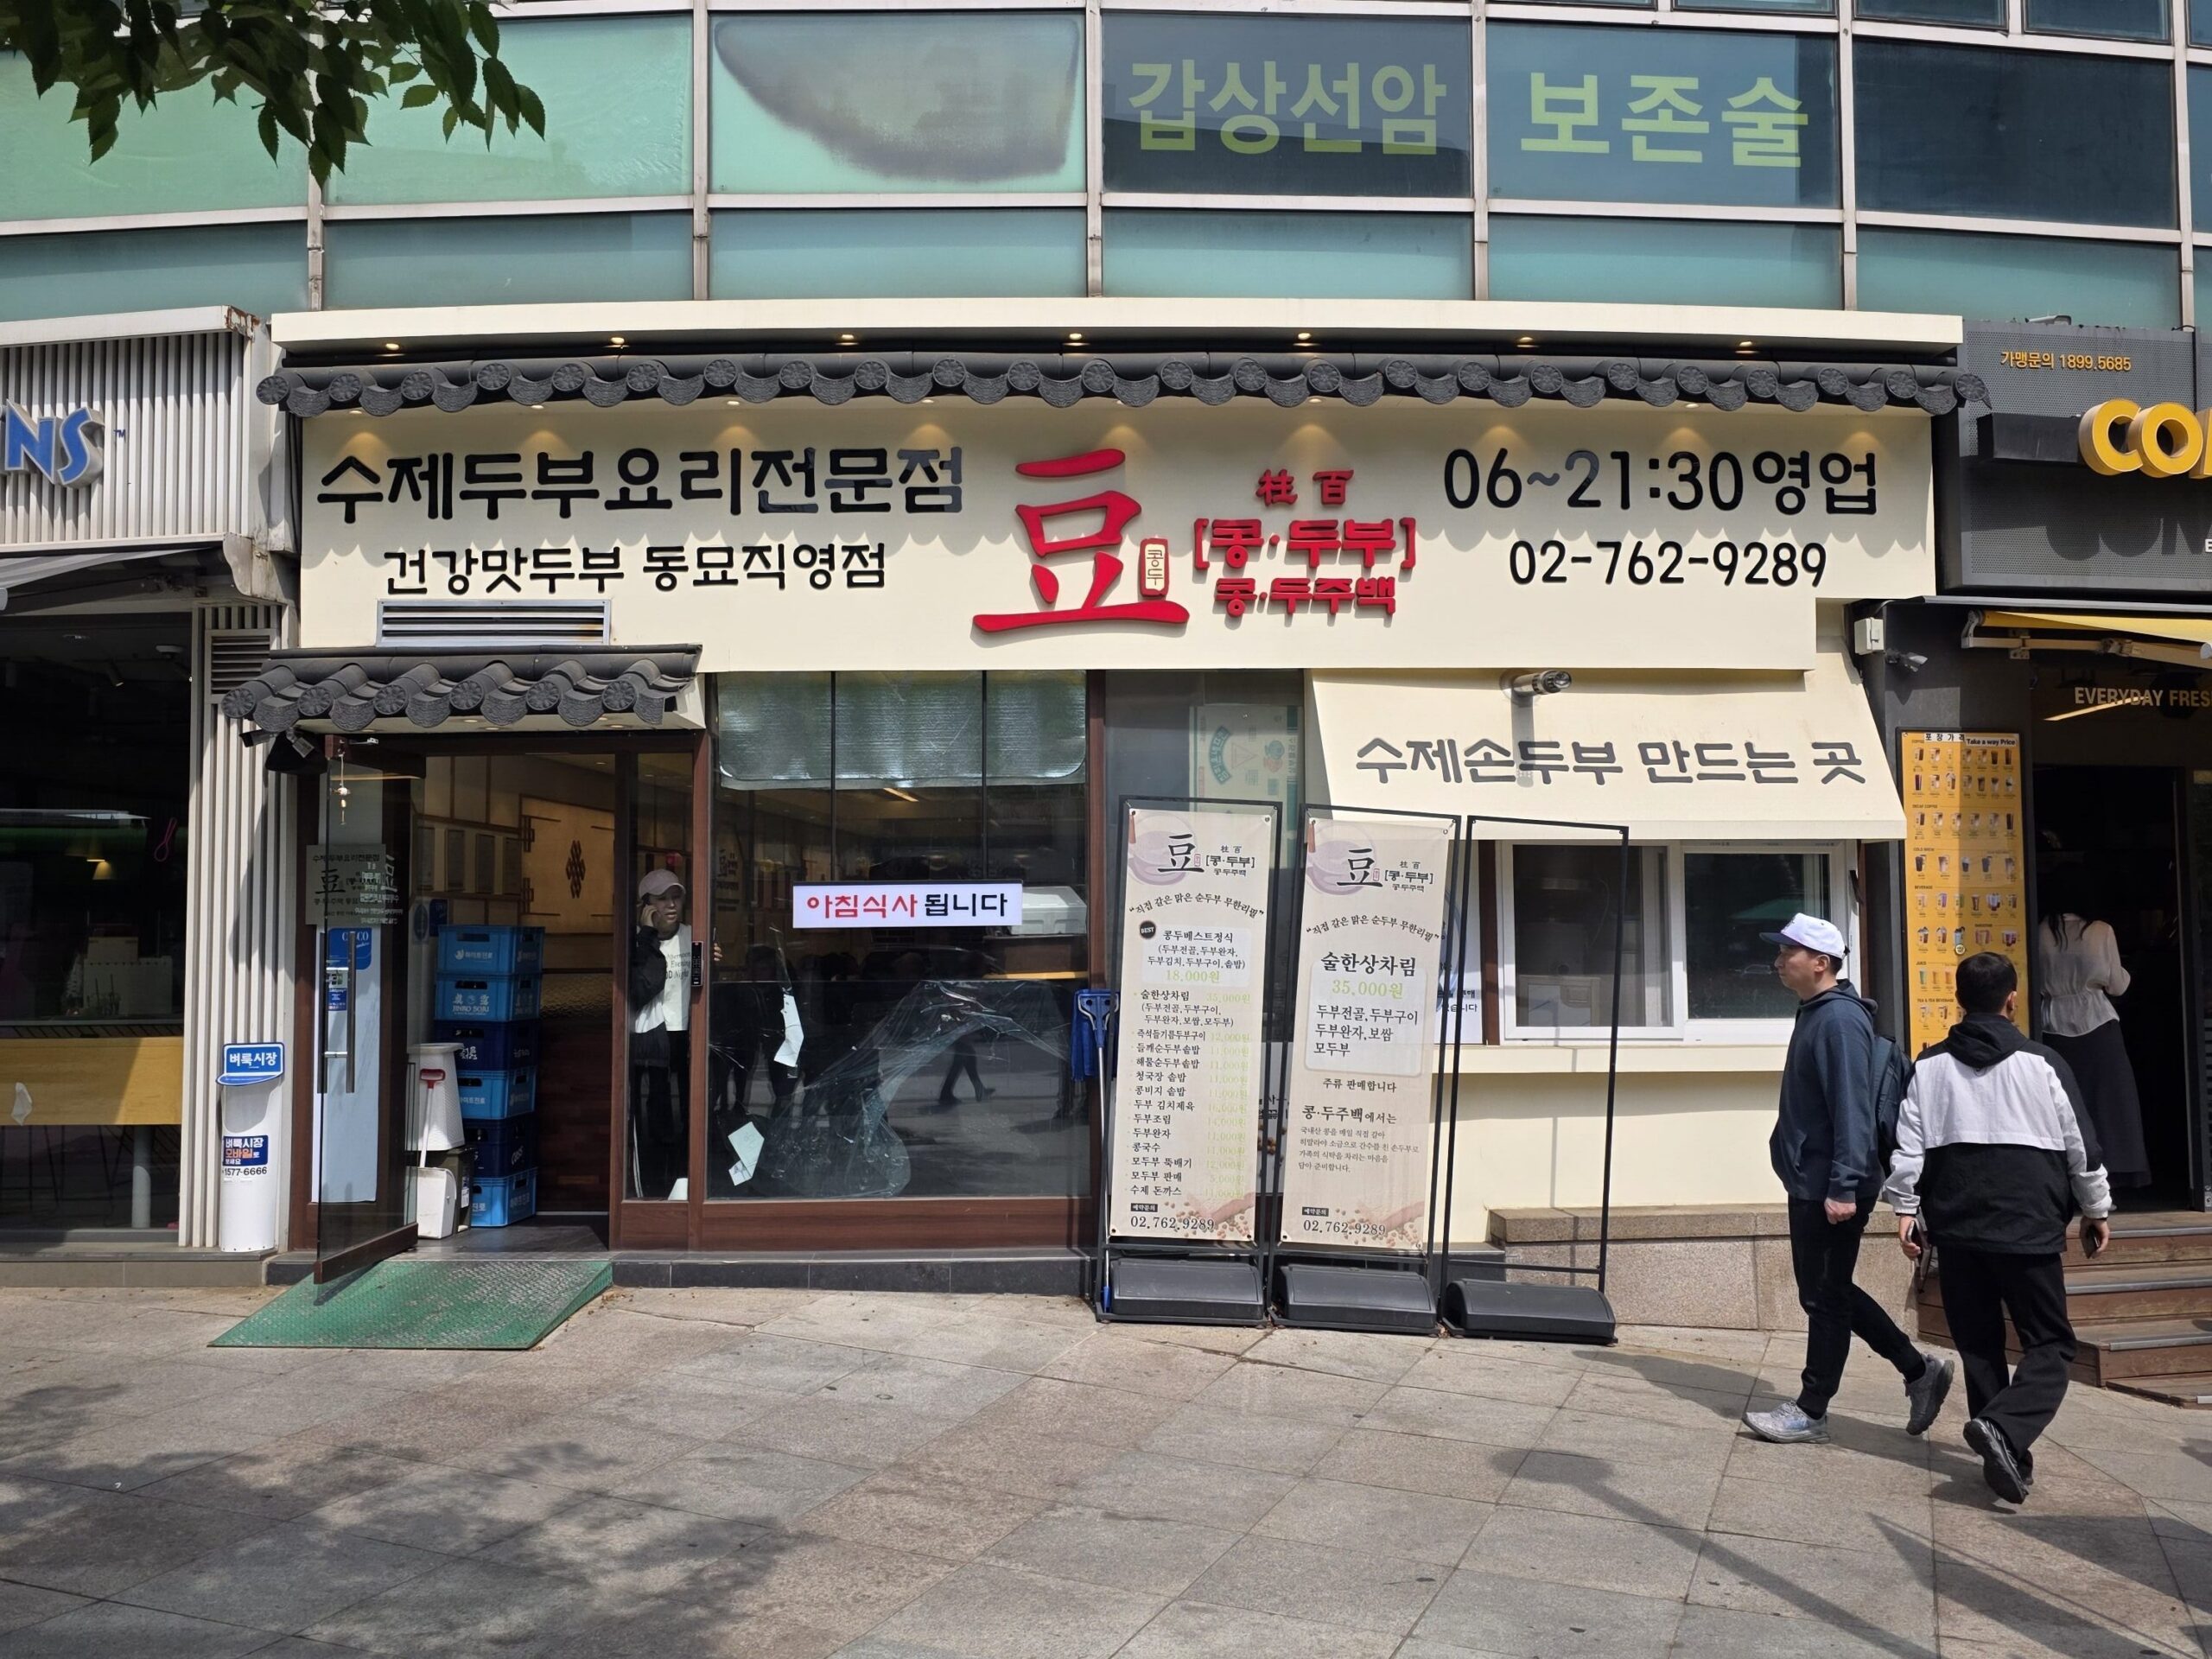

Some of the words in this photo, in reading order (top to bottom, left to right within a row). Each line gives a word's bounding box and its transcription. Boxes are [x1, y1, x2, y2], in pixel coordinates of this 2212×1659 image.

[1128, 59, 1447, 156] 갑상선암
[1520, 72, 1809, 168] 보존술
[2000, 351, 2054, 369] 가맹문의
[2059, 354, 2132, 372] 1899.5685
[0, 398, 105, 486] NS
[2079, 398, 2212, 479] CO
[317, 447, 963, 524] 수제두부요리전문점
[1444, 448, 1878, 516] 06~21:30영업
[972, 448, 1190, 632] 豆
[384, 547, 625, 594] 건강맛두부
[642, 543, 887, 592] 동묘직영점
[1510, 539, 1827, 588] 02-762-9289
[2074, 687, 2164, 707] EVERYDAY
[2169, 690, 2212, 708] FRES
[1355, 736, 1624, 785] 수제손두부
[1637, 739, 1799, 785] 만드는
[1811, 741, 1866, 785] 곳
[1157, 833, 1205, 873] 豆
[1337, 849, 1382, 887] 豆
[807, 893, 918, 918] 아침식사
[925, 893, 1007, 917] 됩니다
[1195, 893, 1223, 905] 순두부
[1371, 915, 1398, 927] 순두부
[342, 931, 369, 942] CCO
[1163, 930, 1234, 944] 콩두베스트정식
[1320, 951, 1416, 977] 술한상차림
[1141, 989, 1190, 1001] 술한상차림
[1313, 1042, 1351, 1058] 모두부
[229, 1052, 277, 1066] 벼룩시장
[1135, 1071, 1164, 1082] 청국장
[1135, 1085, 1163, 1096] 콩비지
[1323, 1077, 1343, 1090] 주류
[1346, 1079, 1397, 1093] 판매합니다
[1134, 1100, 1153, 1110] 두부
[1157, 1101, 1195, 1111] 김치제육
[1133, 1114, 1171, 1125] 두부조림
[1133, 1128, 1171, 1139] 두부완자
[1300, 1127, 1321, 1135] 국내산
[226, 1138, 264, 1149] 벼룩시장
[1132, 1142, 1160, 1154] 콩국수
[1131, 1156, 1160, 1166] 모두부
[1164, 1158, 1192, 1168] 뚝배기
[224, 1166, 267, 1176] 1577-6666
[1131, 1171, 1160, 1181] 모두부
[1163, 1172, 1182, 1182] 판매
[1130, 1185, 1148, 1196] 수제
[1154, 1185, 1182, 1197] 돈까스
[1130, 1216, 1215, 1230] 02.762.9289
[1303, 1220, 1386, 1236] 02.762.9289
